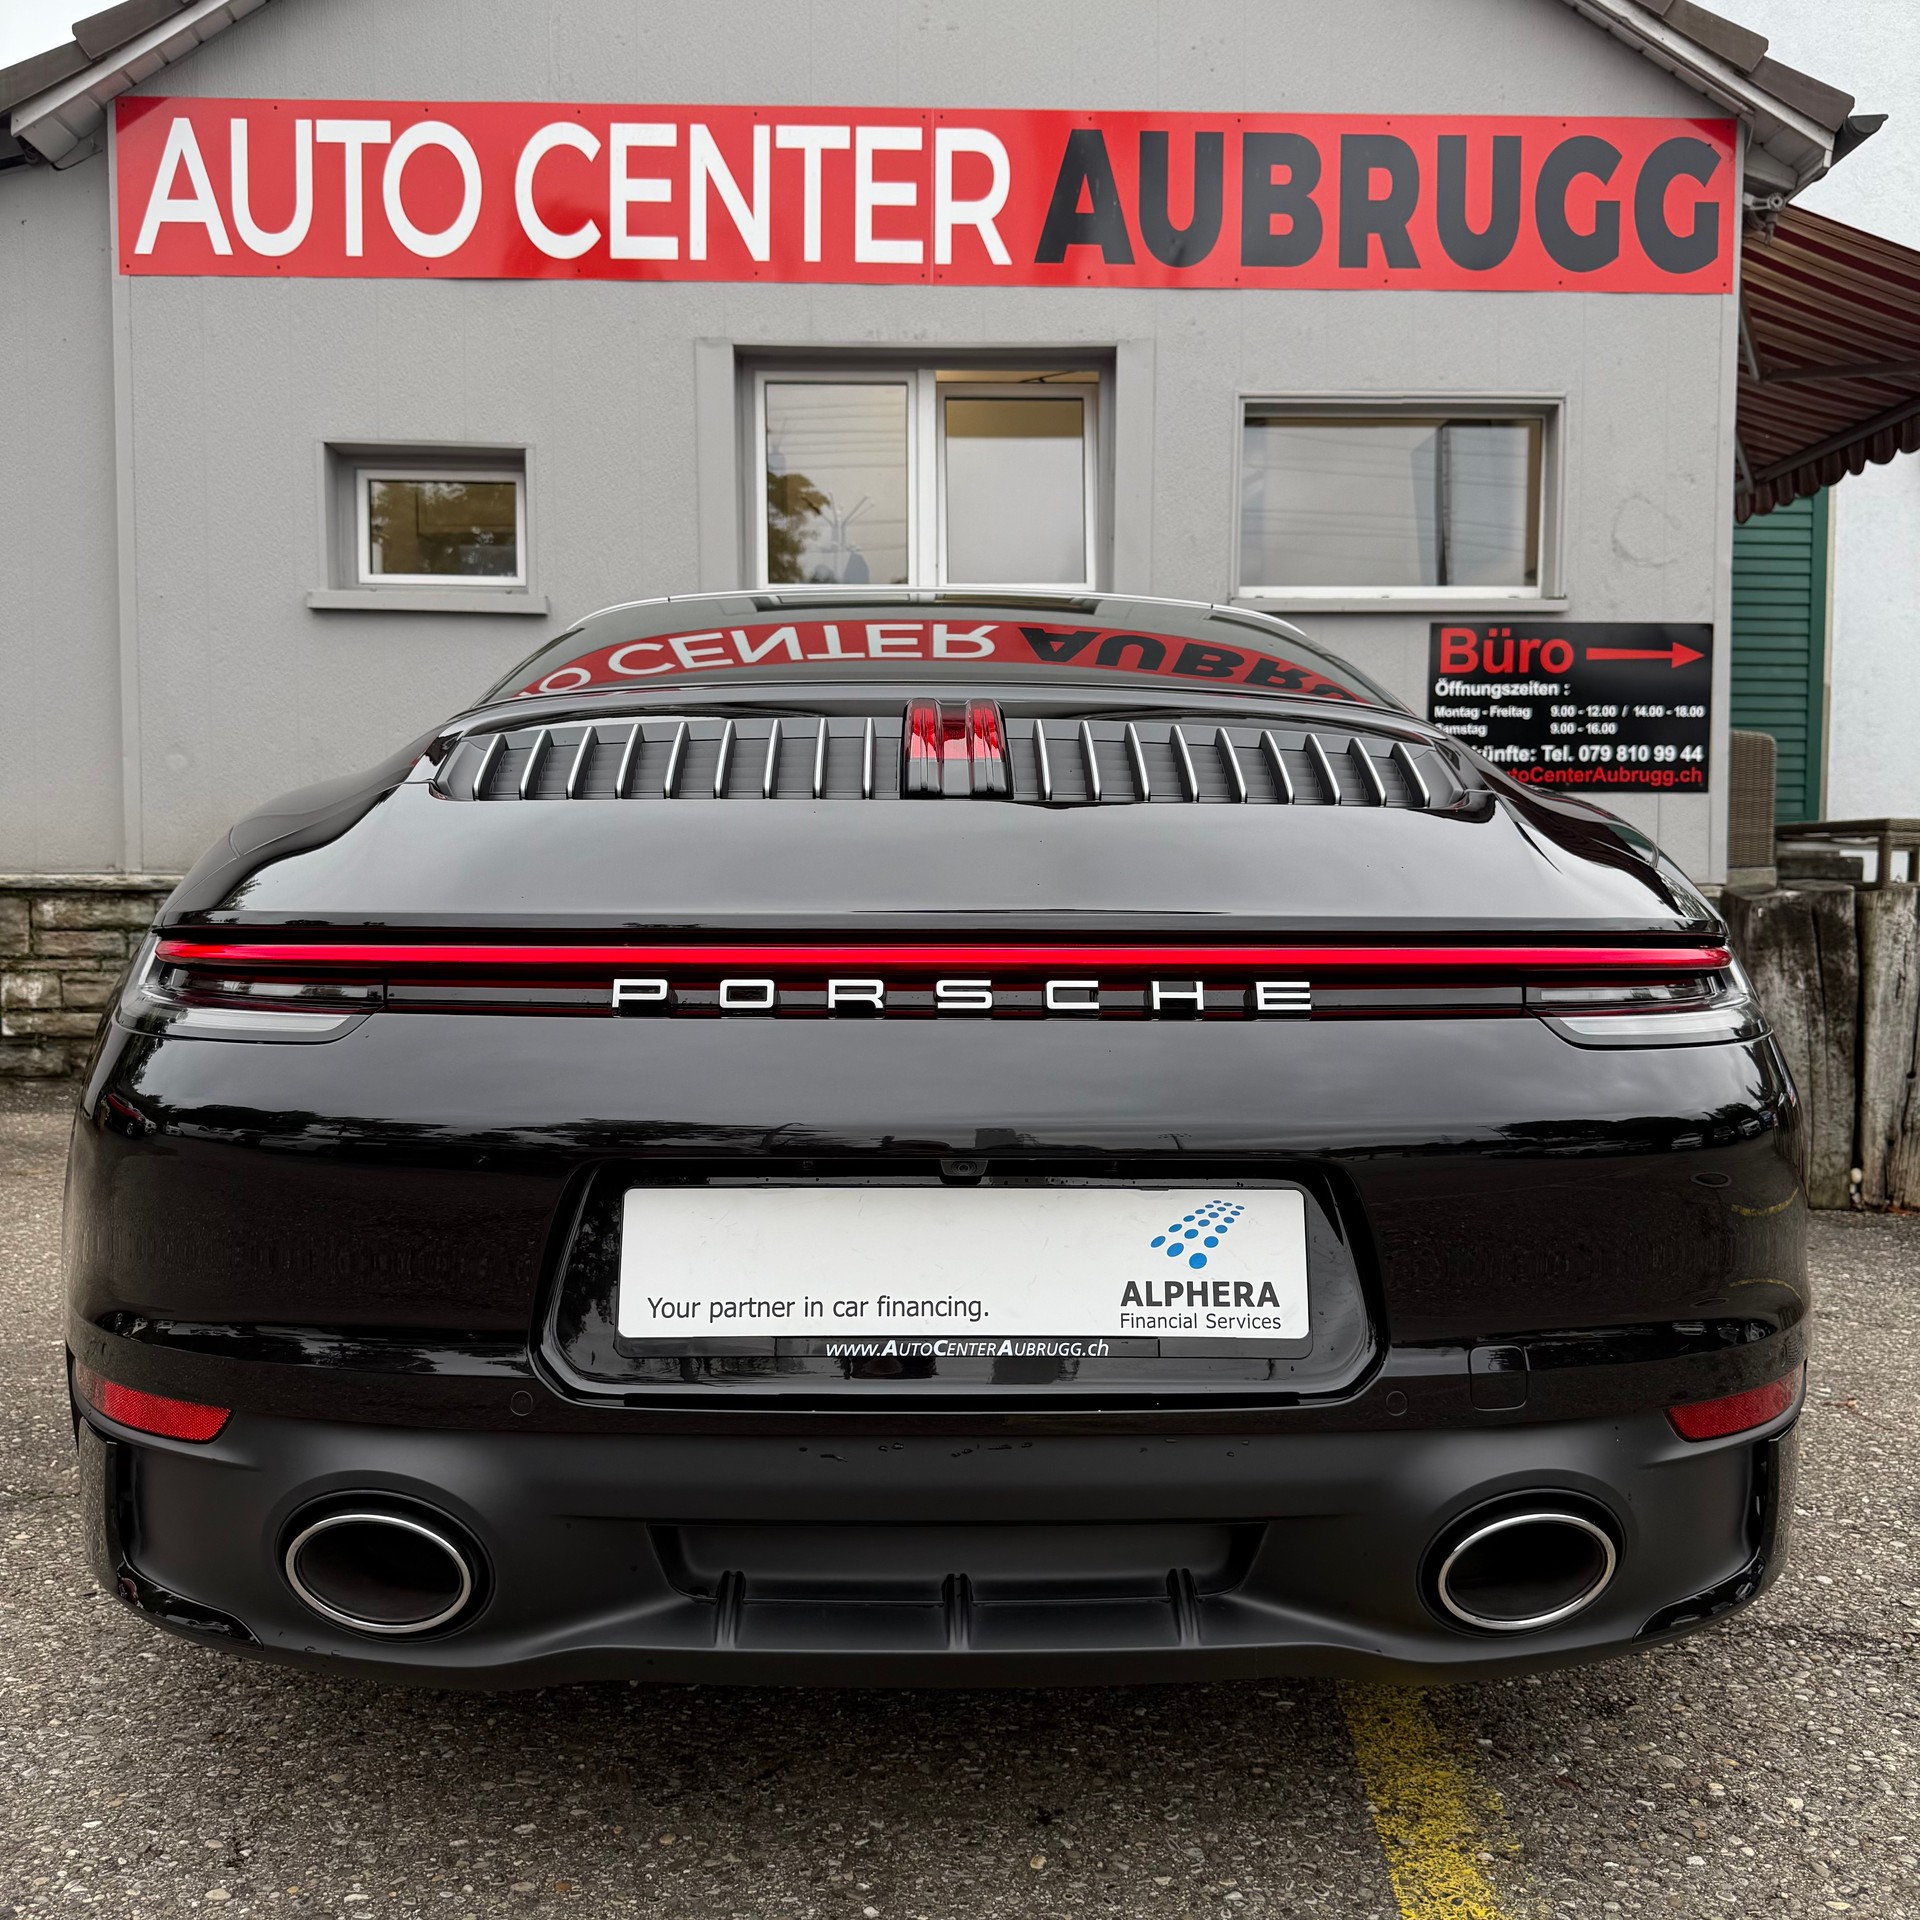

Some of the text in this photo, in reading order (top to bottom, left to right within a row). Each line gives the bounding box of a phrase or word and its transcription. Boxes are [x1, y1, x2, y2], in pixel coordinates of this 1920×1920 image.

[135, 117, 1722, 274] AUTO CENTER AUBRUGG
[1439, 627, 1574, 674] Büro
[1435, 678, 1560, 699] Öffnungszeiten
[1434, 705, 1480, 720] Montag
[1489, 705, 1533, 720] Freitag
[1550, 705, 1576, 718] 9.00
[1586, 705, 1617, 717] 12.00
[1633, 705, 1665, 717] 14.00
[1674, 705, 1705, 717] 18.00
[1550, 722, 1576, 735] 9.00
[1585, 722, 1617, 734] 16.00
[1541, 744, 1574, 762] Tel.
[1578, 745, 1613, 762] 079
[1616, 745, 1650, 762] 810
[1653, 745, 1677, 762] 99
[1680, 745, 1704, 762] 44
[1507, 766, 1703, 787] toCenterAubrugg.ch
[611, 978, 1312, 1011] PORSCHE
[1120, 1280, 1280, 1307] ALPHERA
[647, 1295, 990, 1324] Your partner in car financing.
[1120, 1312, 1282, 1330] Financial Services
